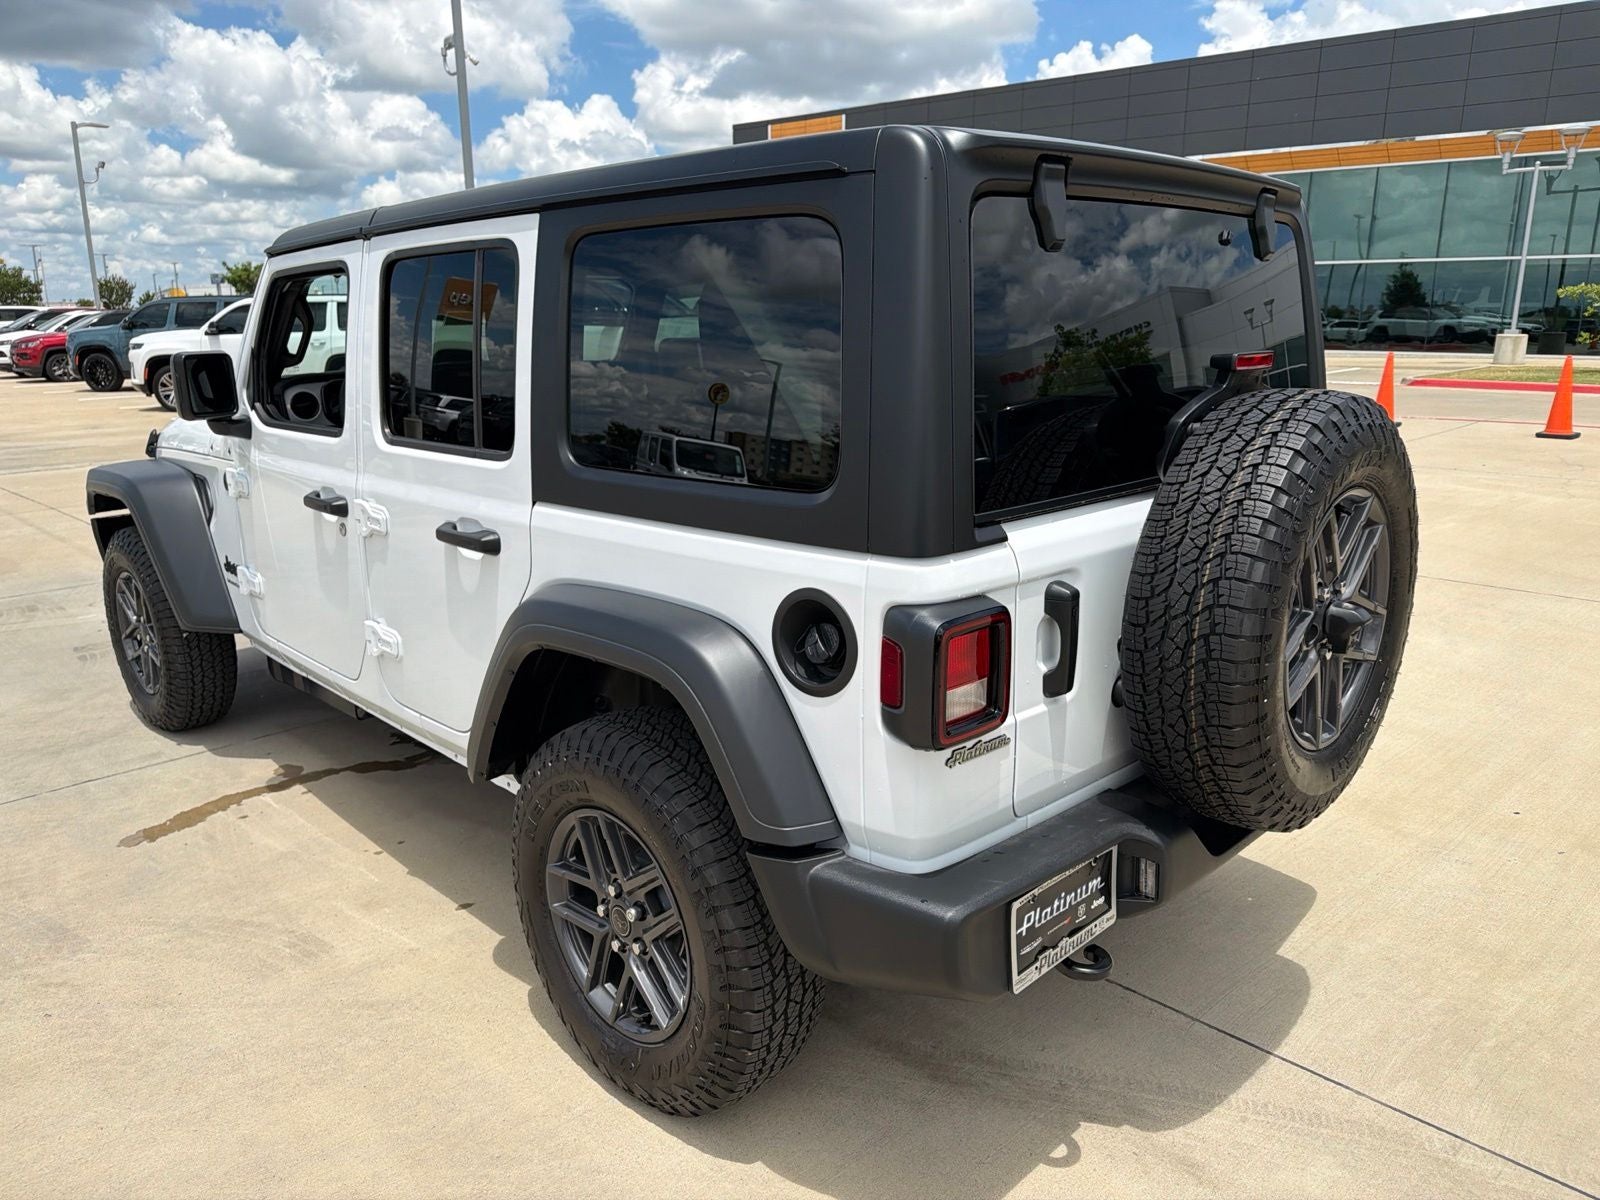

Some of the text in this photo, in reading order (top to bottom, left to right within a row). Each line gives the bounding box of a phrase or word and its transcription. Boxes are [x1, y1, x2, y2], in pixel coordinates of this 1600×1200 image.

[945, 733, 1011, 769] Platinum
[1016, 876, 1105, 936] Platinum
[1038, 925, 1097, 976] Platinum
